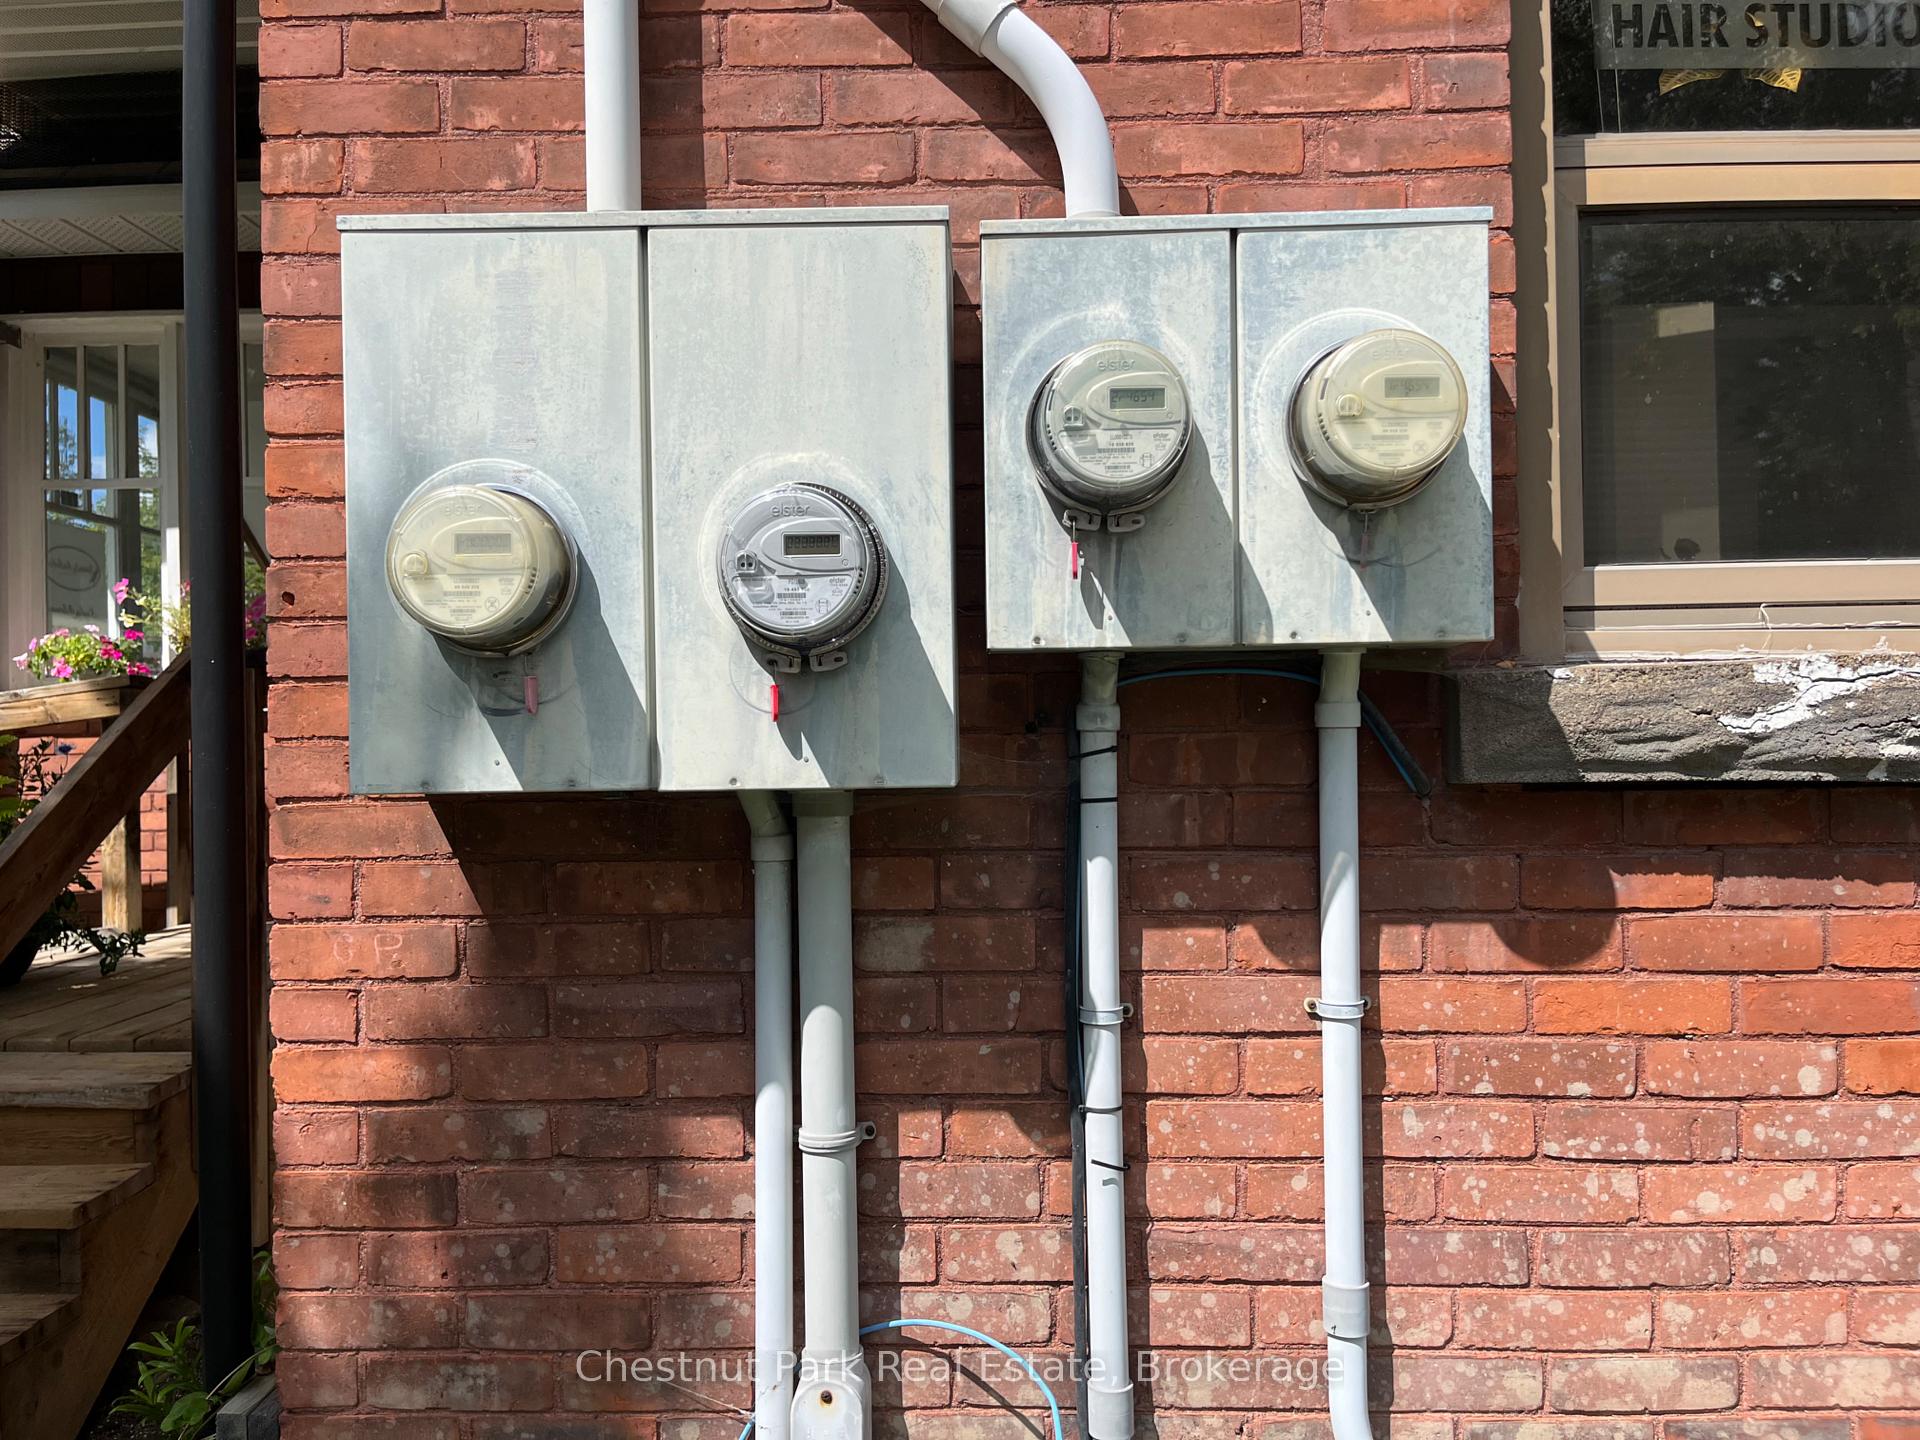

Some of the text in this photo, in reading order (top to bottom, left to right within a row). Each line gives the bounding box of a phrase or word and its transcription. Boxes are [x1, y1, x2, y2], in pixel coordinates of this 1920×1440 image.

[1612, 2, 1920, 48] HAIR STUDIO
[770, 503, 810, 517] elster
